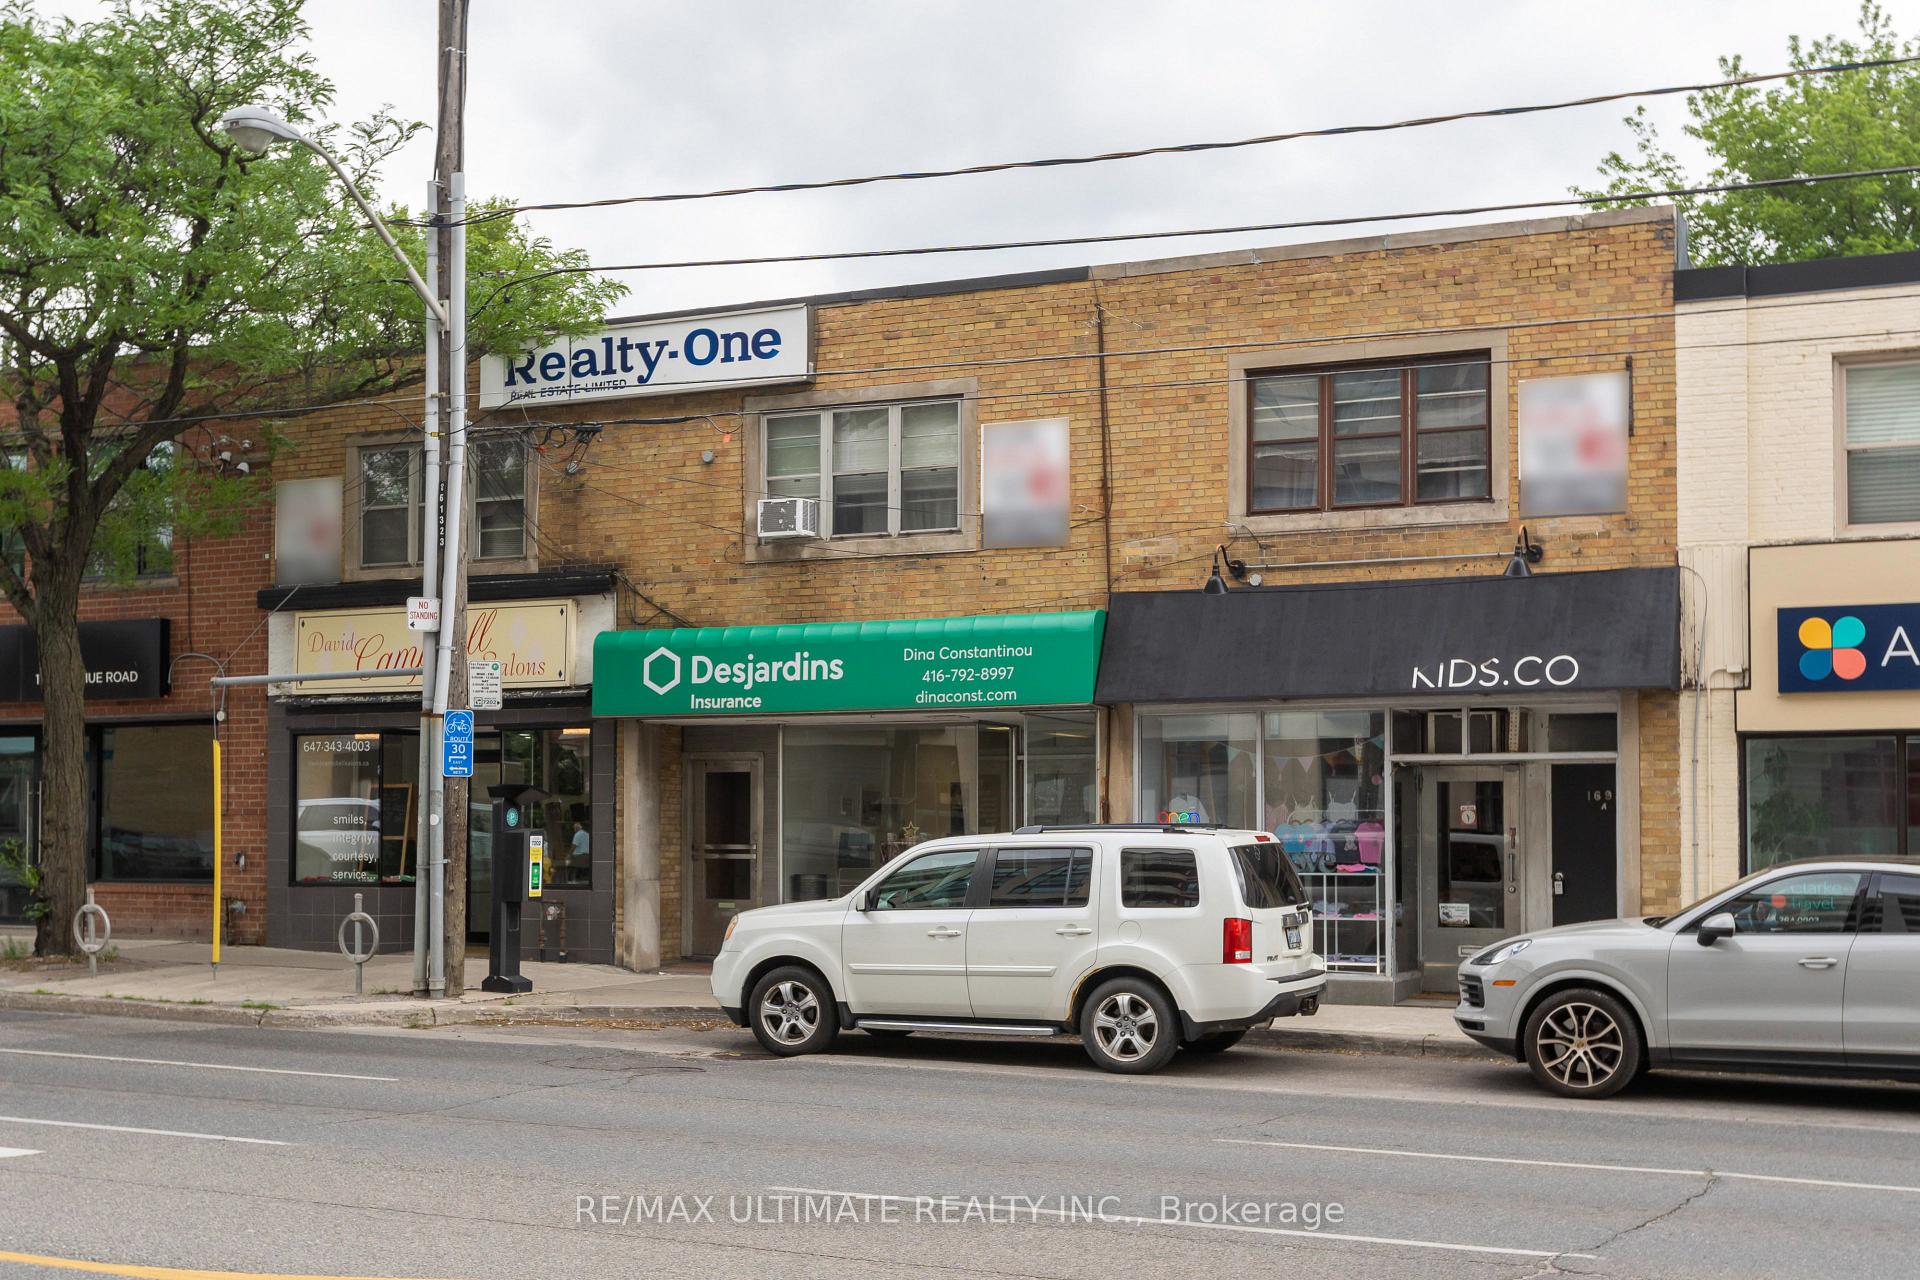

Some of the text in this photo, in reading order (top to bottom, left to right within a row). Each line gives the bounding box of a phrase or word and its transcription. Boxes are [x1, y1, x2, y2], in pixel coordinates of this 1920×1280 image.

[504, 328, 782, 386] Realty-One
[540, 384, 581, 398] ESTATE
[585, 379, 627, 393] LIMITED
[419, 601, 429, 609] NO
[410, 611, 438, 620] STANDING
[308, 609, 546, 685] David Camll alons
[903, 645, 1033, 661] Dina Constantinou
[105, 670, 138, 683] ROAD
[691, 651, 844, 690] Desjardins
[922, 666, 1014, 682] 416-792-8997
[1411, 655, 1579, 689] KIDS.CO
[690, 694, 762, 709] Insurance
[915, 689, 1017, 704] dinaconst.com
[452, 744, 466, 754] 30
[333, 814, 367, 825] smiles,
[332, 851, 377, 864] courtesy,
